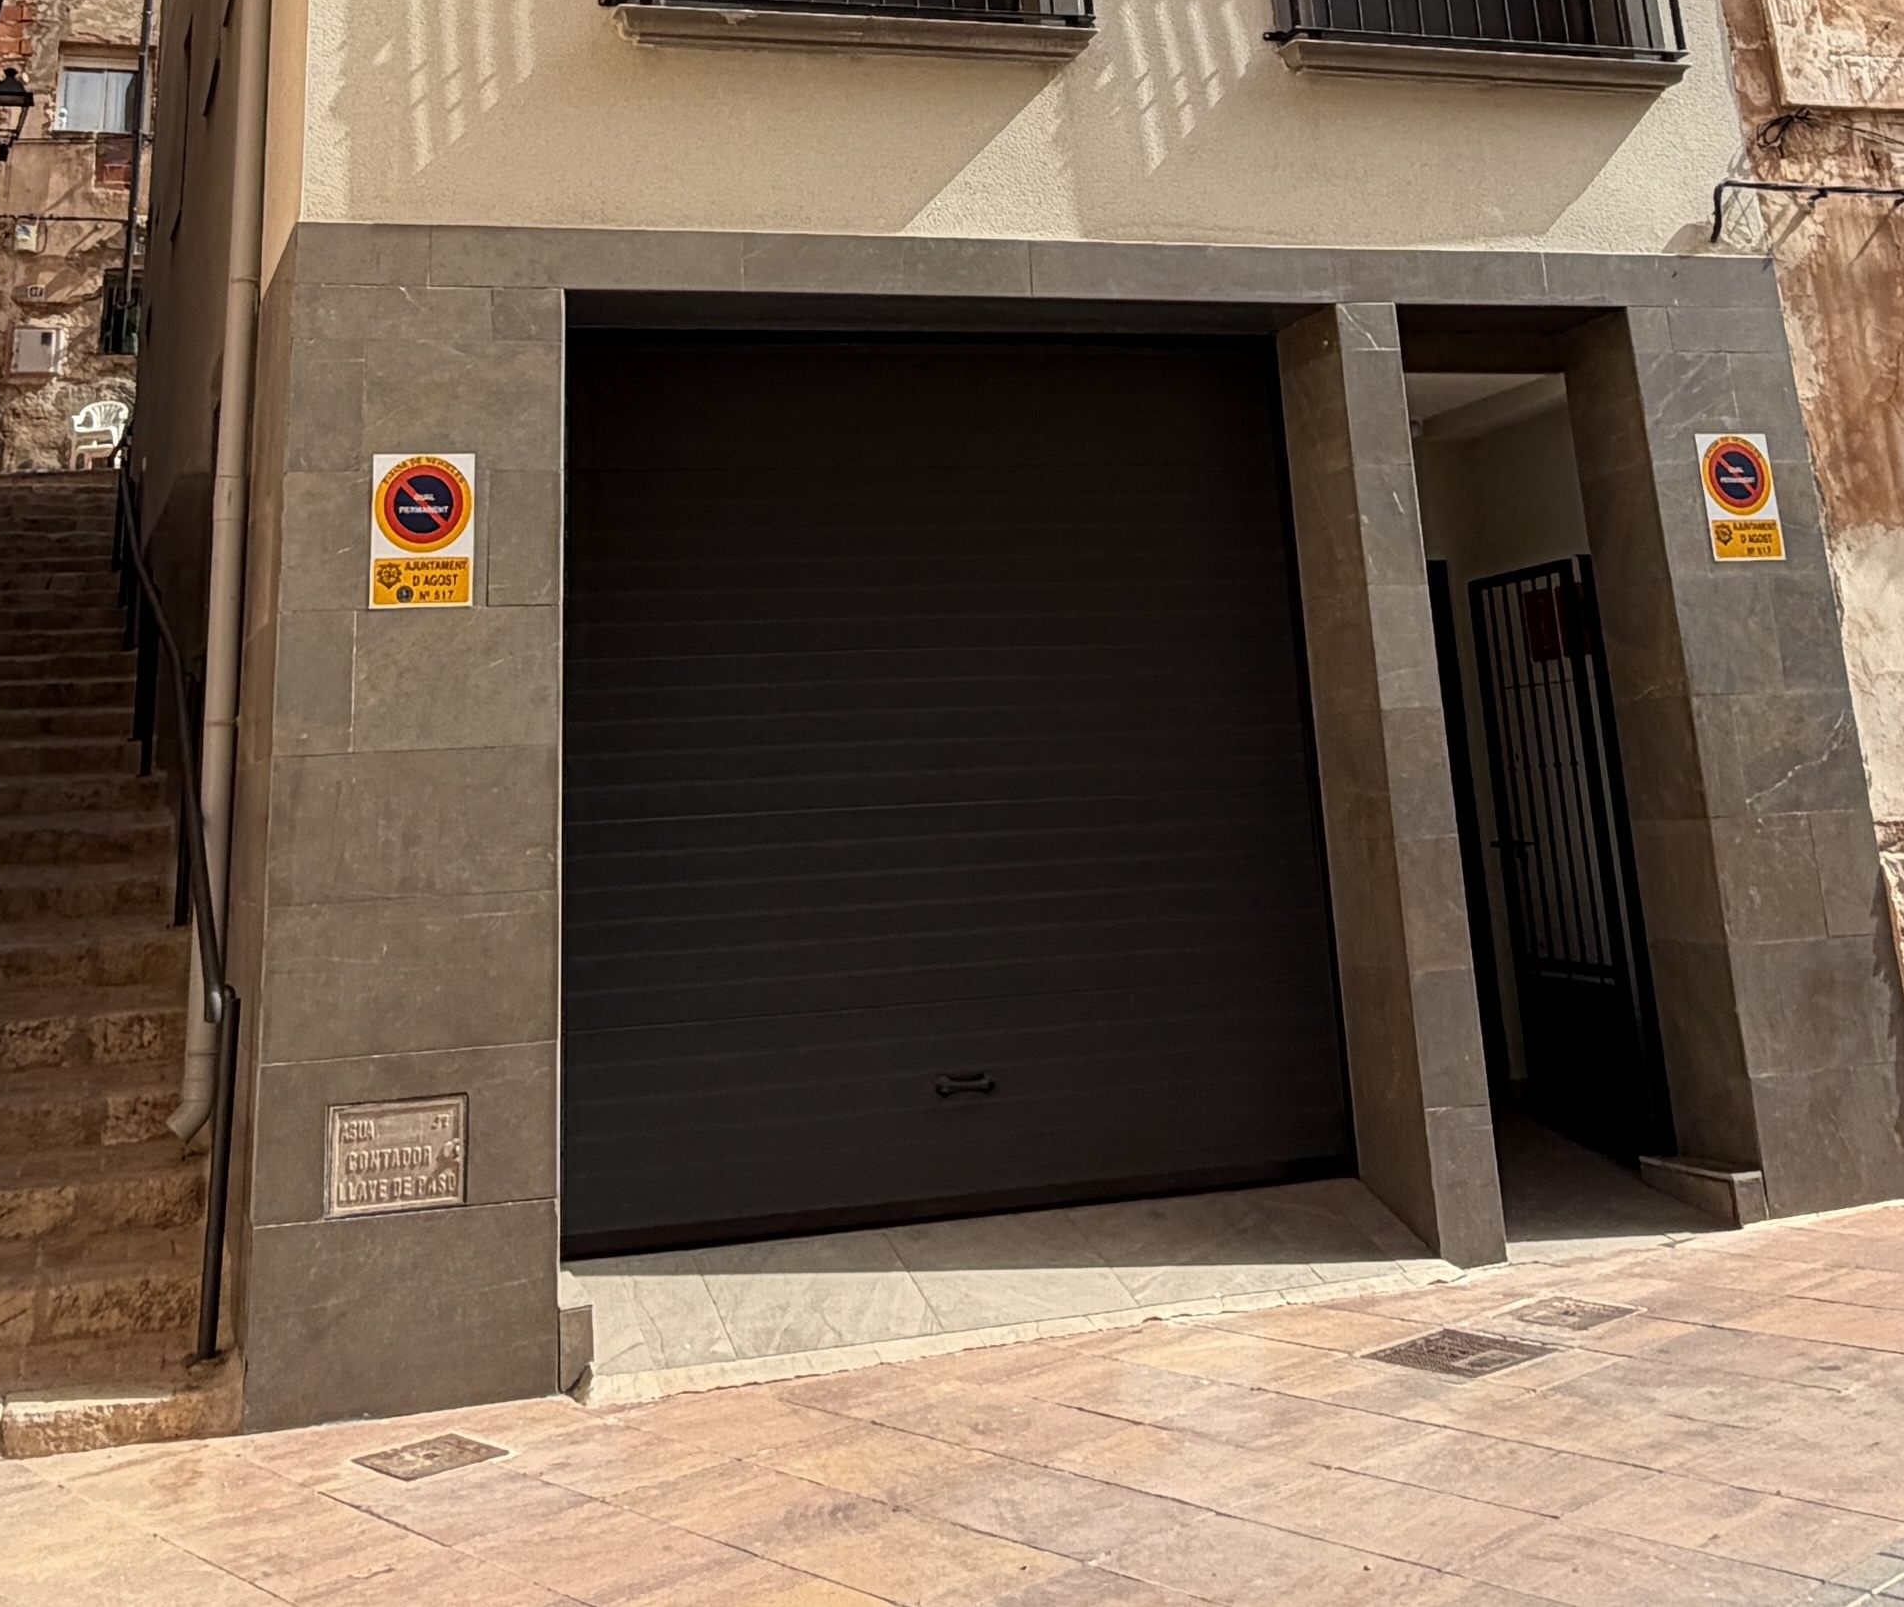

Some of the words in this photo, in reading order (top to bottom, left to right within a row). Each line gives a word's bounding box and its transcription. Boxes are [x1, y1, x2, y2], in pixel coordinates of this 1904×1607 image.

[404, 560, 467, 572] AJUNTAMENT
[340, 1119, 376, 1143] AGUA
[346, 1145, 433, 1174] CONTADOR
[338, 1178, 389, 1203] LLAVE
[391, 1175, 412, 1198] DE
[416, 1170, 457, 1196] PASO
